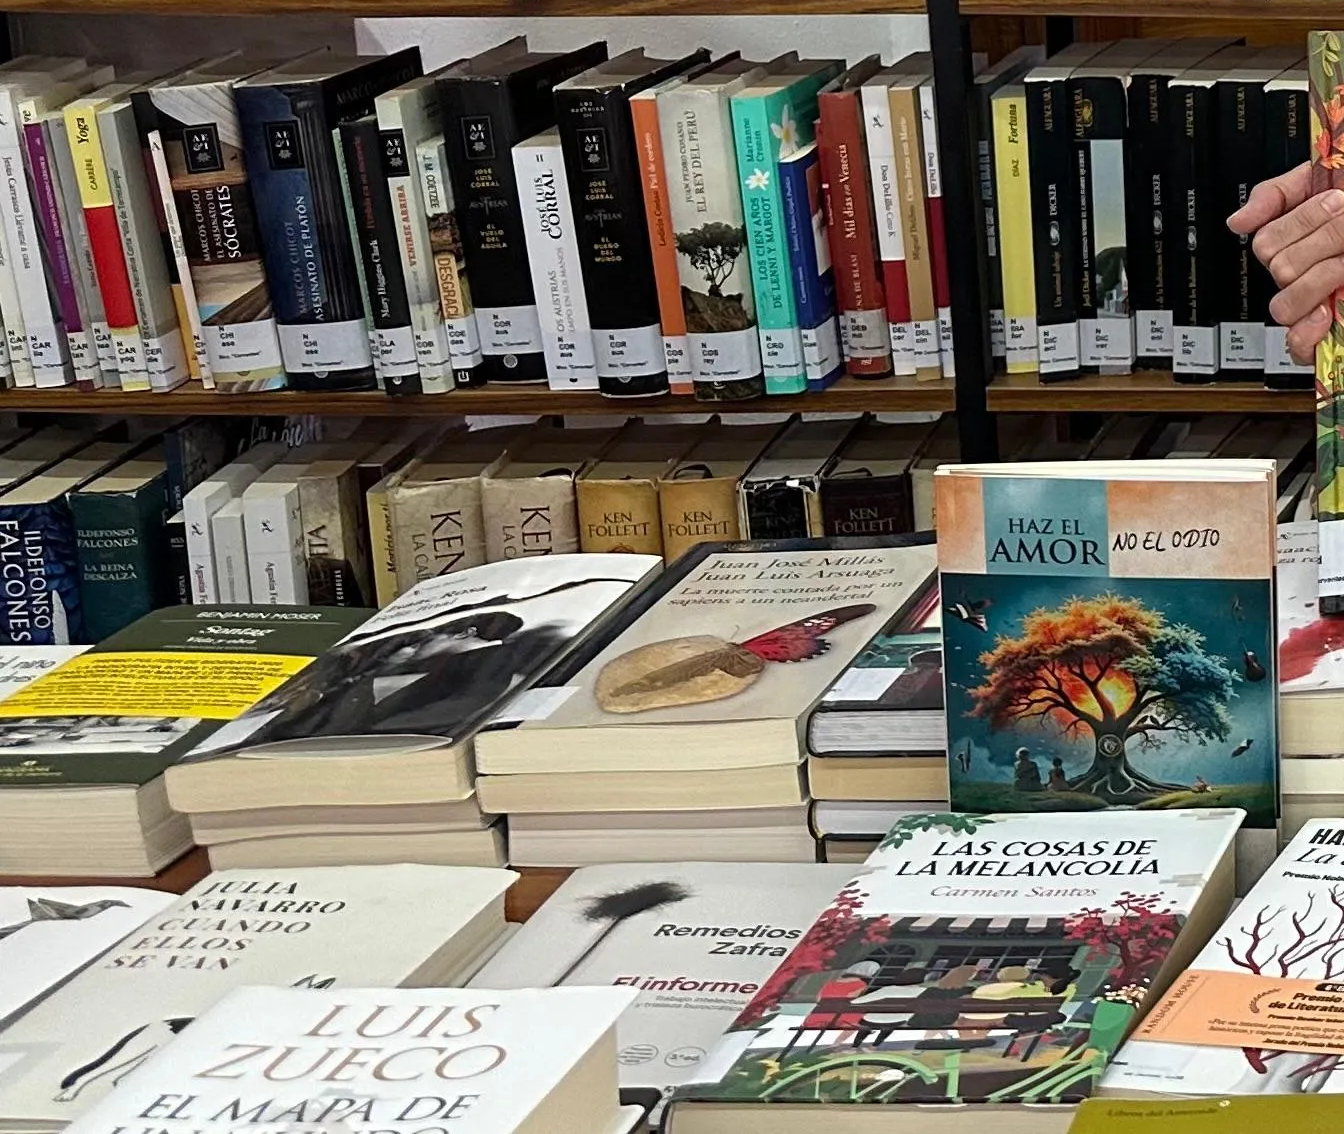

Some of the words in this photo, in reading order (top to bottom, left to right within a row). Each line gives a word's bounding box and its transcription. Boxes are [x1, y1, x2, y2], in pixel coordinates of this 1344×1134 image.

[76, 117, 86, 145] Yoga
[1008, 104, 1018, 145] Fortuna
[548, 168, 564, 240] CORRAL
[1048, 183, 1058, 216] DECKER
[217, 184, 241, 259] SÓCRATES
[603, 511, 633, 524] KEN
[1008, 518, 1053, 535] HAZ
[1061, 519, 1084, 535] EL
[76, 536, 139, 548] FALCONES
[588, 522, 650, 538] FOLLETT
[1112, 532, 1137, 552] NO
[1143, 532, 1165, 552] EL
[1172, 528, 1220, 548] ODIO
[989, 538, 1106, 565] AMOR
[0, 520, 31, 642] FALCONES
[22, 530, 52, 629] ILDEFONSO
[931, 841, 996, 856] LAS
[1002, 841, 1109, 856] COSAS
[1114, 839, 1157, 856] DE
[1292, 847, 1339, 865] La
[896, 860, 946, 875] LA
[949, 856, 1160, 876] MELANCOLÍA
[930, 885, 1019, 897] Carmen
[1024, 885, 1097, 897] Santos
[653, 924, 802, 940] Remedios
[708, 941, 787, 957] Zafra
[304, 1003, 501, 1039] LUIS
[195, 1044, 509, 1082] ZUECO
